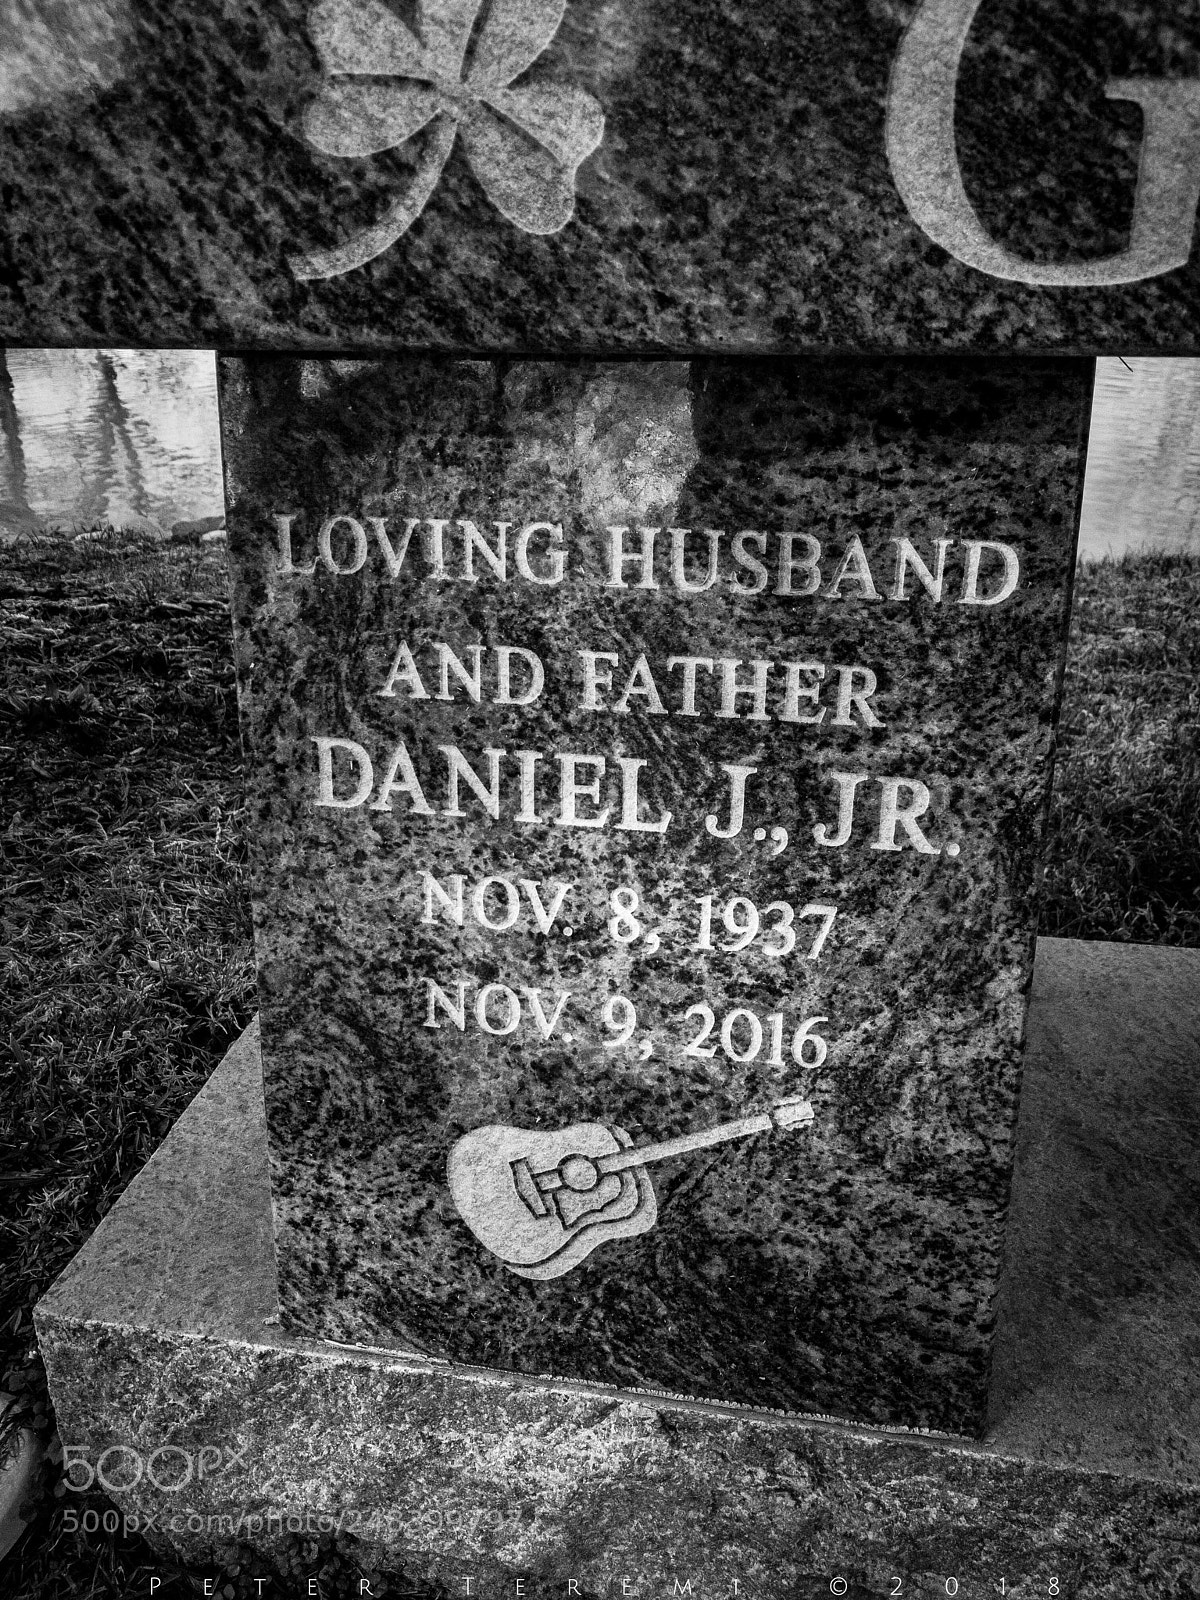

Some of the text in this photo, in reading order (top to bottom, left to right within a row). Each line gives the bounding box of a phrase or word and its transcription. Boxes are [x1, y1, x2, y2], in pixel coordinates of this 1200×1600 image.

[273, 513, 1019, 605] LOVING HUSBAND
[376, 640, 886, 728] AND FATHER
[311, 736, 961, 855] DANIEL J., JR.
[416, 871, 838, 960] NOV. 8, 1937
[420, 977, 829, 1068] NOV. 9, 2016
